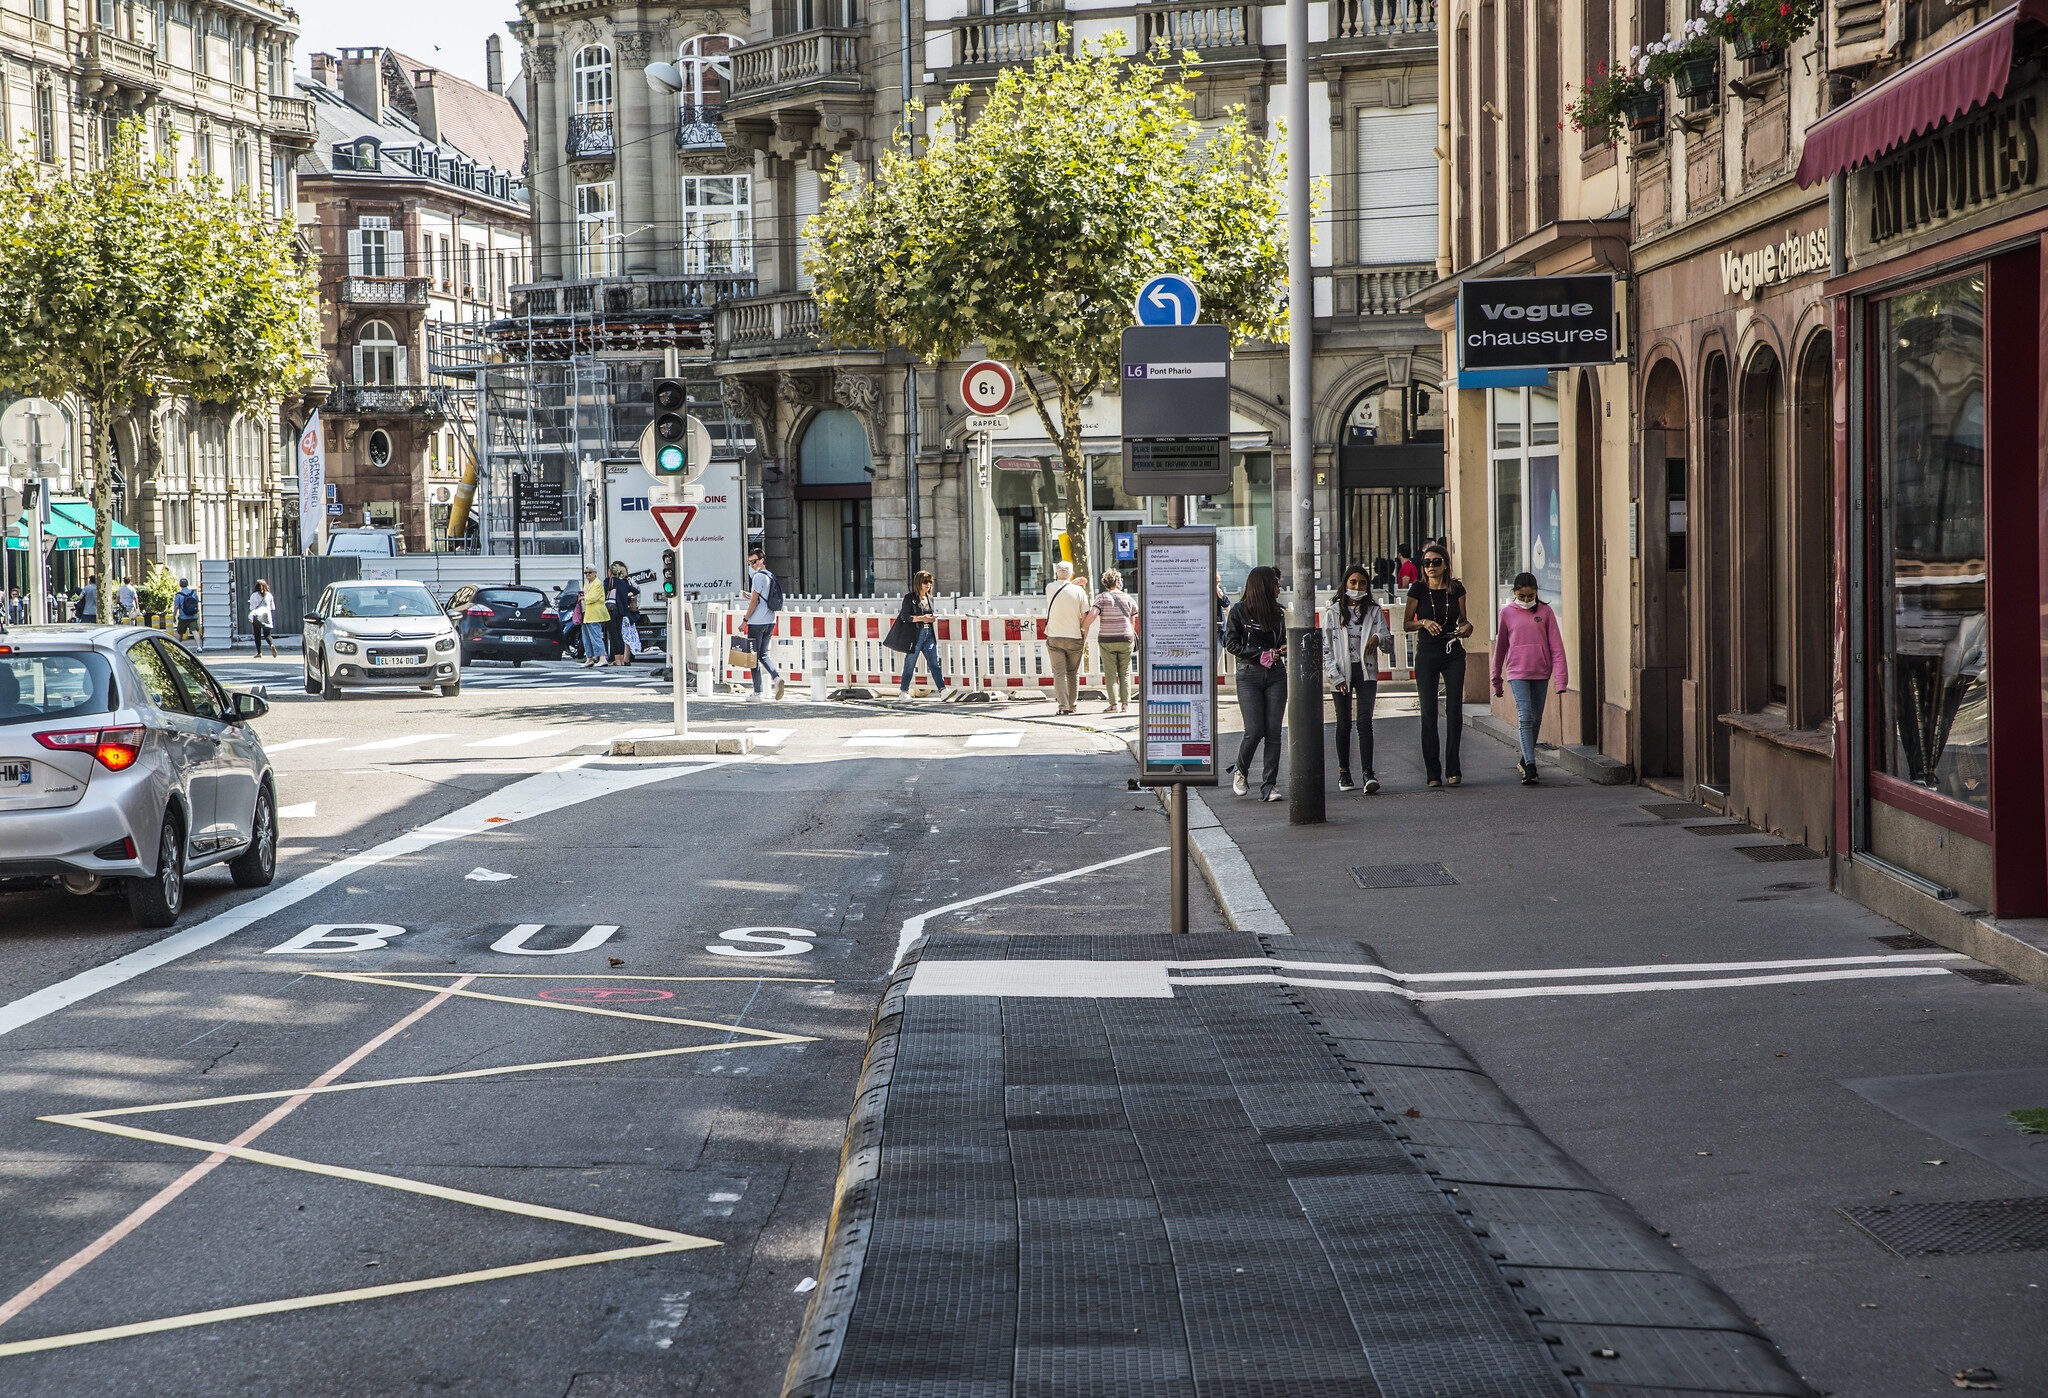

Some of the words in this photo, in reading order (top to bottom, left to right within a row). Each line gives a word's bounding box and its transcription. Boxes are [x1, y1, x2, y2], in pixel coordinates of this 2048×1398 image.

[1720, 244, 1776, 301] Vogue
[1480, 302, 1594, 322] Vogue
[1467, 328, 1608, 347] chaussures
[1127, 365, 1143, 377] L6
[1150, 367, 1167, 375] Pont
[1168, 367, 1192, 375] Phario
[21, 772, 30, 781] 67
